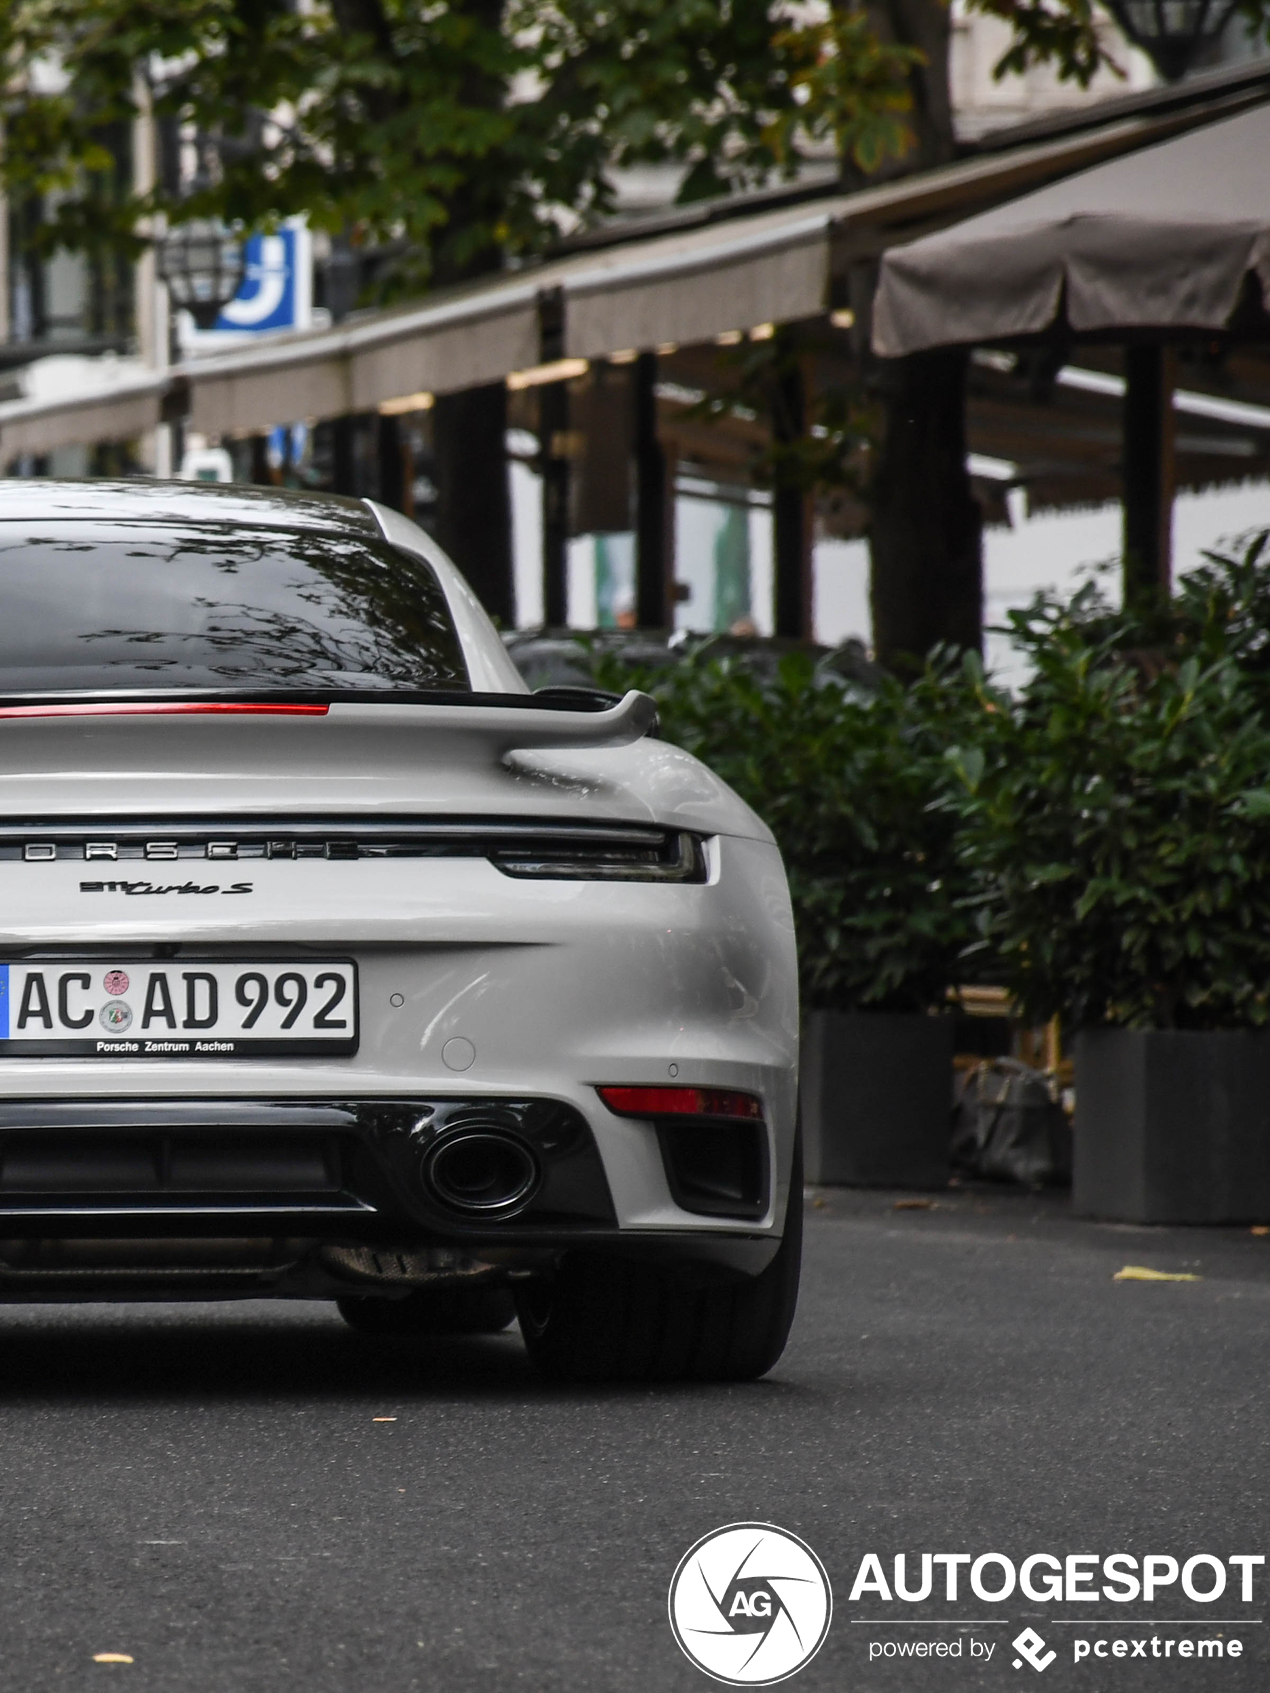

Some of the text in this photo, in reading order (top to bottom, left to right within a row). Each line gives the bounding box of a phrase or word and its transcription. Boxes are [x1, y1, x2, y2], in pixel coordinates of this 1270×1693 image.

[220, 882, 254, 895] S
[16, 972, 95, 1030] AC
[141, 972, 219, 1030] AD
[234, 972, 347, 1030] 992
[96, 1041, 235, 1052] Porsche Zentrum Aachen
